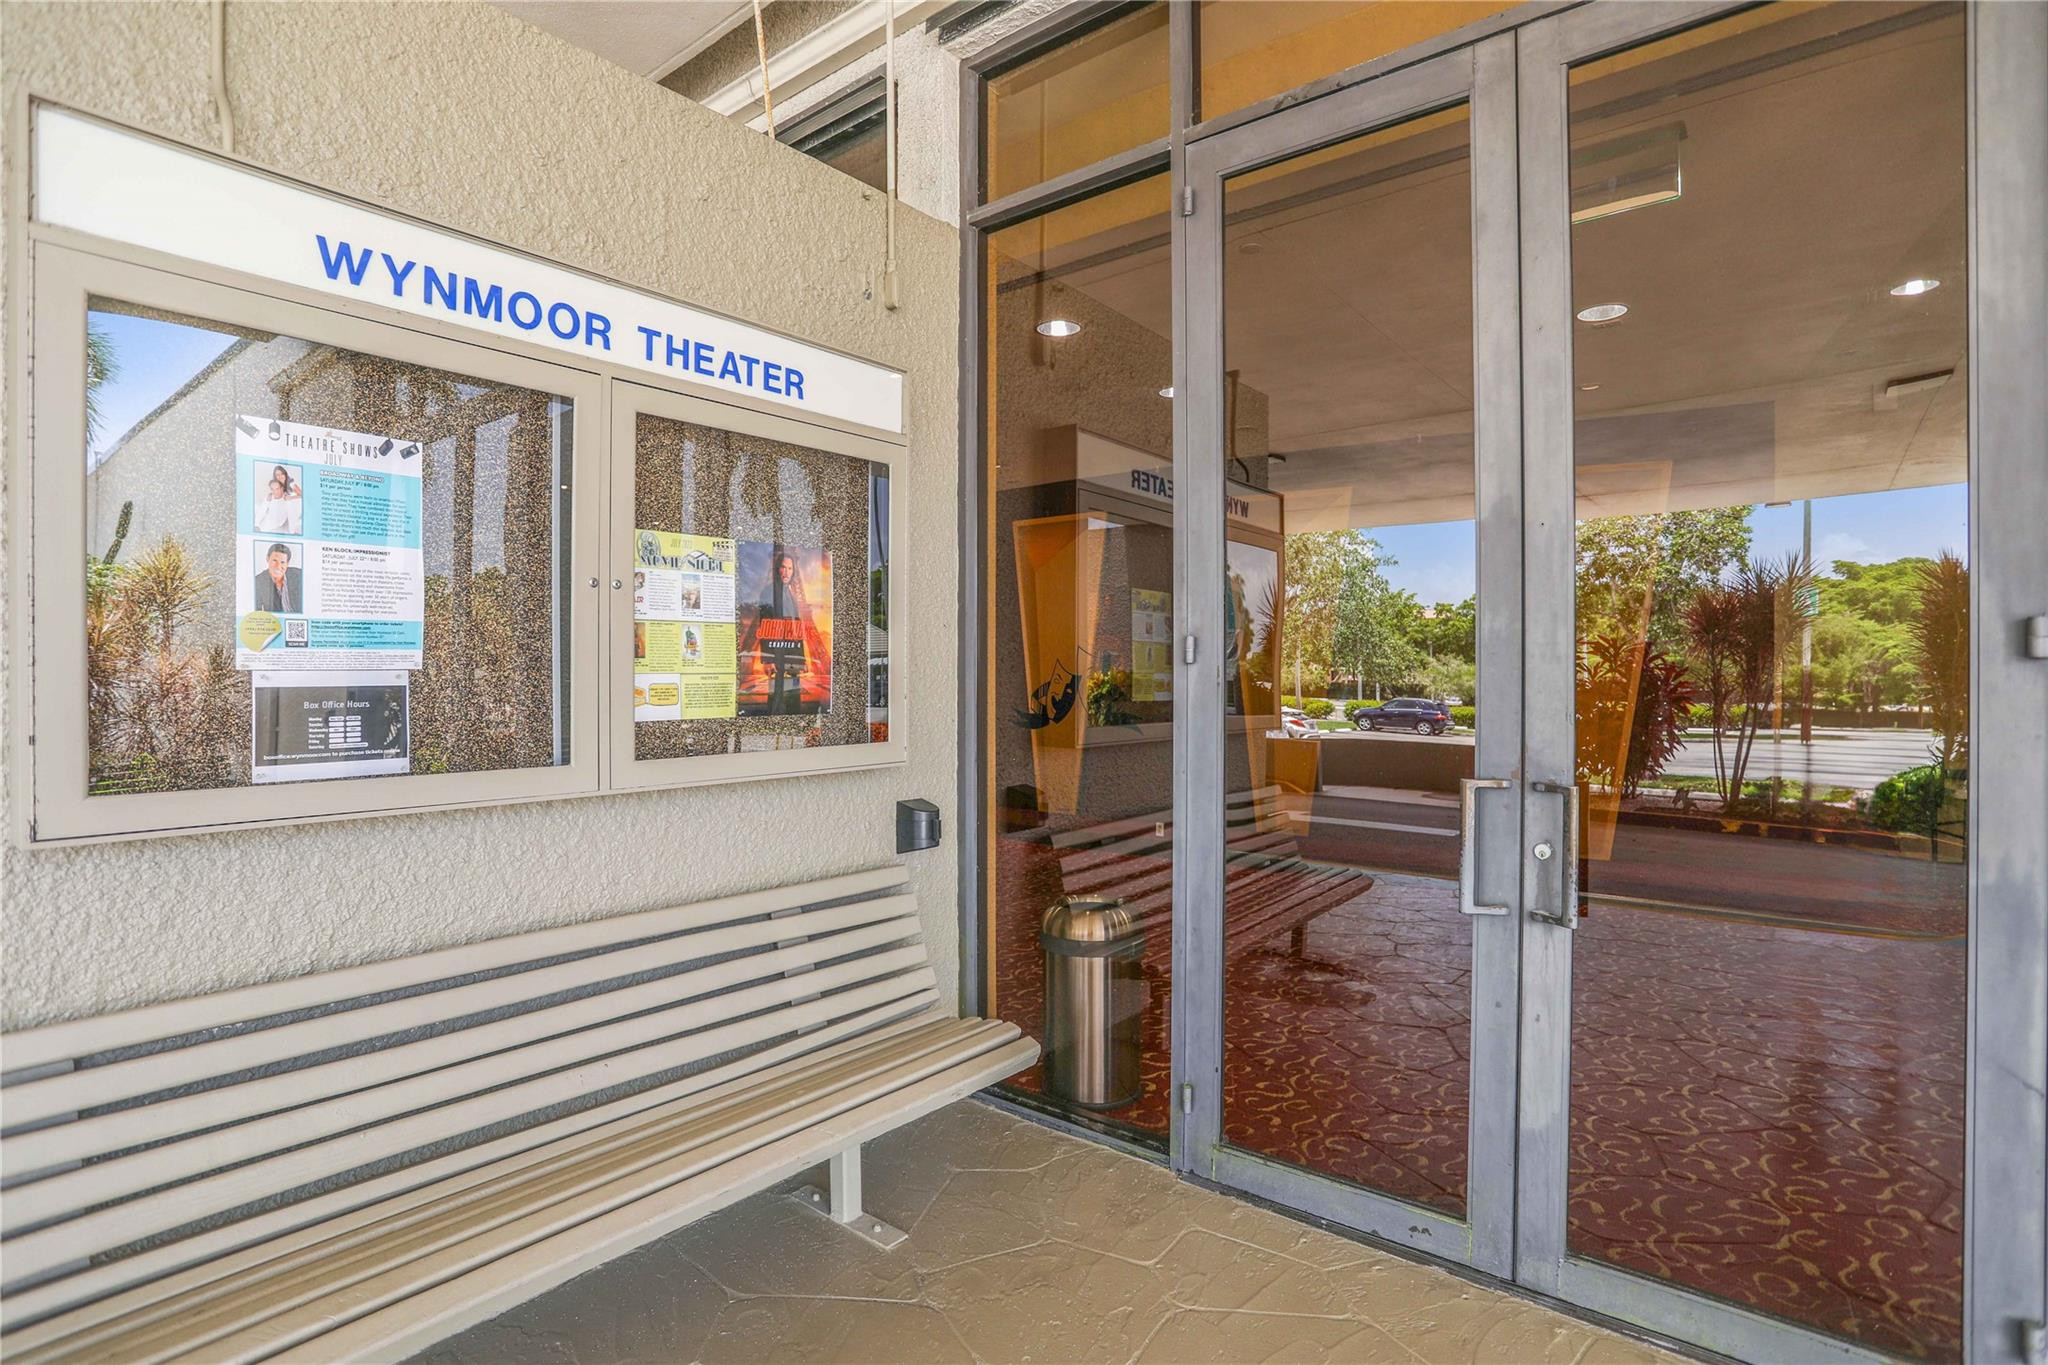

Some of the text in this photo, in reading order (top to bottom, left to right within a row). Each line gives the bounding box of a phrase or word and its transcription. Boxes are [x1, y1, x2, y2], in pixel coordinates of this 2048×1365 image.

[316, 234, 805, 400] WYNMOOR THEATER
[286, 433, 334, 453] THEATRE
[342, 442, 378, 459] SHOWS
[325, 453, 343, 466] JULY
[756, 617, 786, 640] JOHN
[769, 641, 802, 649] CHAPTER 4
[304, 699, 371, 709] Box Office Hours
[339, 748, 365, 758] purchase
[365, 747, 384, 755] tickets
